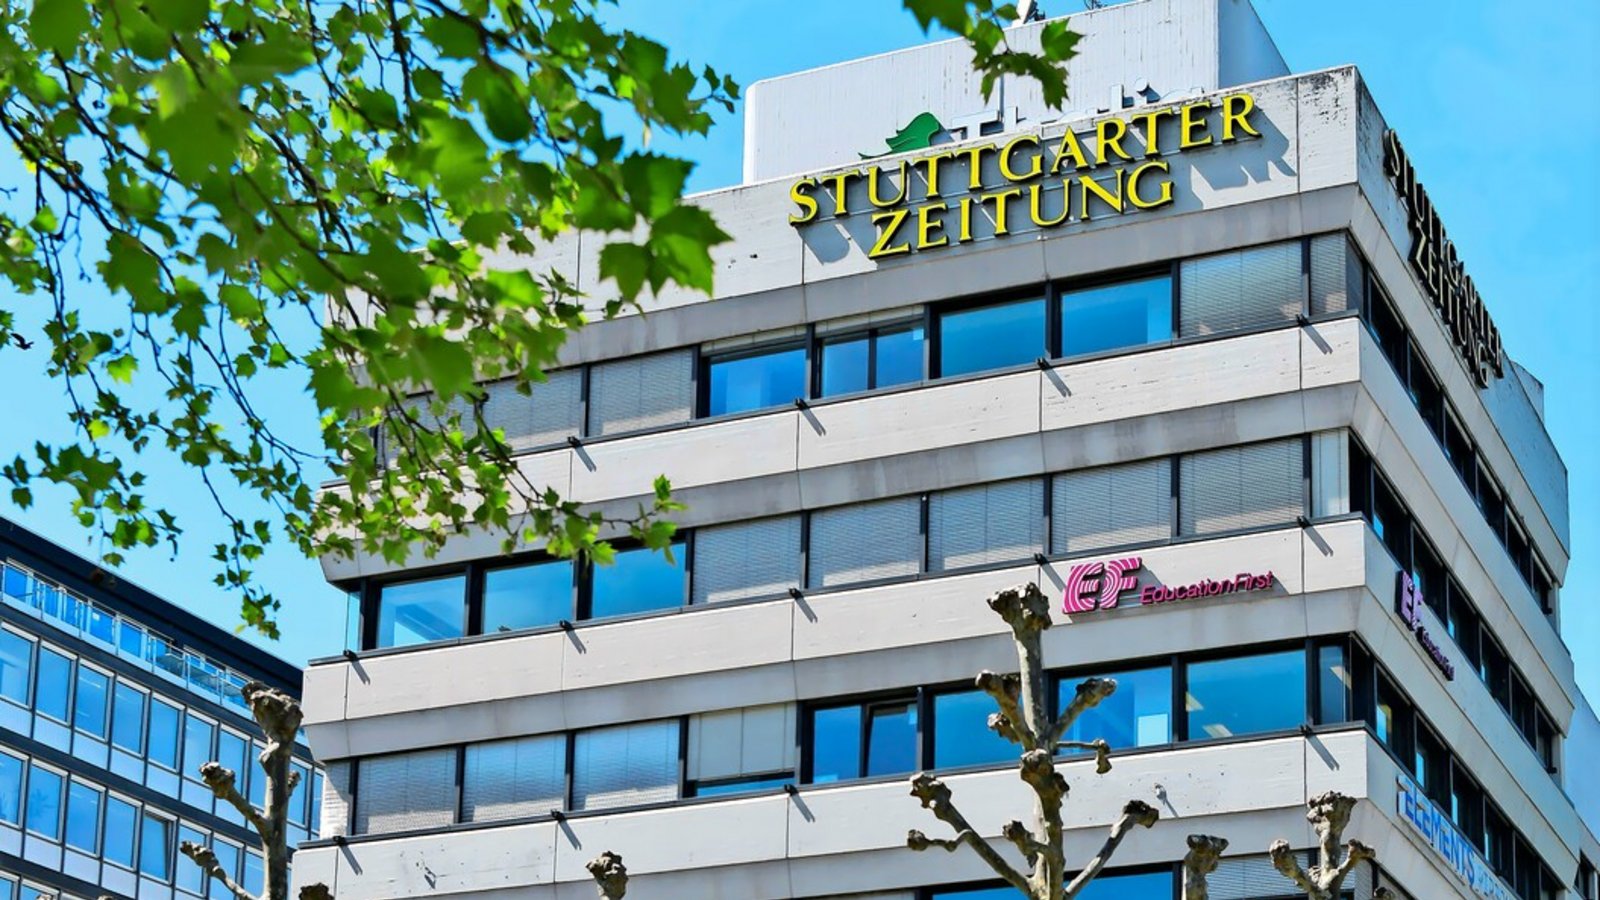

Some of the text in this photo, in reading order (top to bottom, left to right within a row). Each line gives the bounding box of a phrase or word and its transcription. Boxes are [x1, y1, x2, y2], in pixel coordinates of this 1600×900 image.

[789, 93, 1263, 226] STUTTGARTER
[868, 160, 1175, 259] ZEITUNG
[1062, 557, 1142, 614] EF
[1139, 570, 1275, 605] Education First
